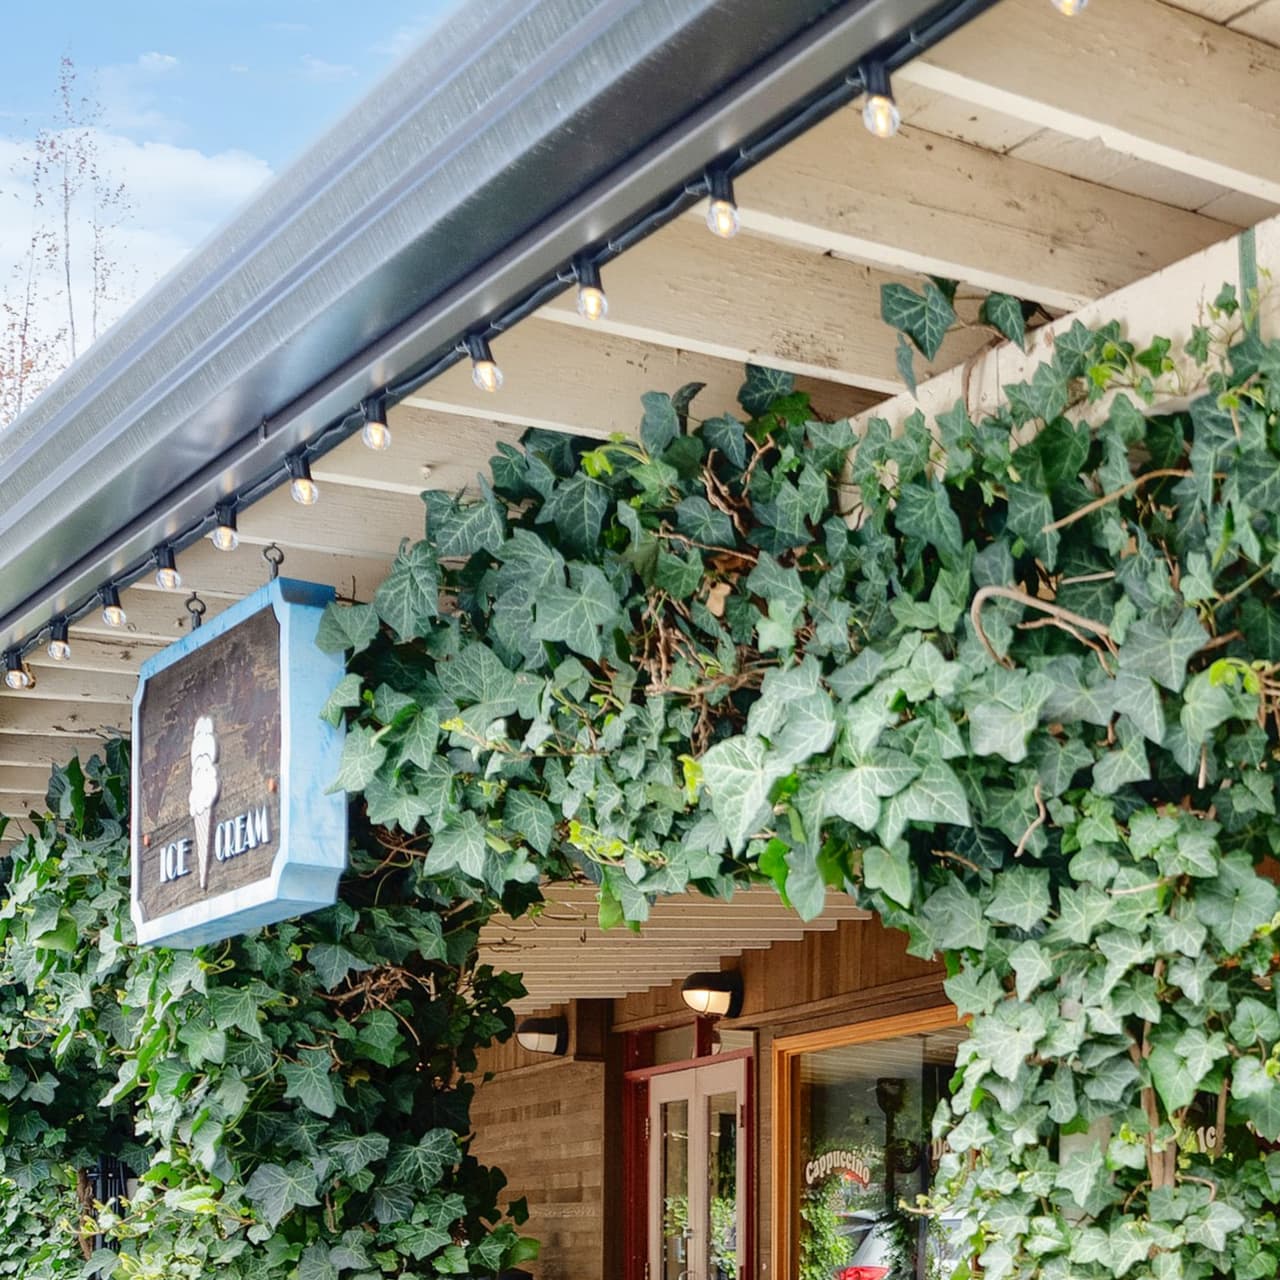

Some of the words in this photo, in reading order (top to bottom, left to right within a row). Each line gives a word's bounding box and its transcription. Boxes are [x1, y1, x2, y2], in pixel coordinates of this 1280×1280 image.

[160, 837, 189, 883] ICE
[214, 804, 270, 863] CREAM
[805, 1150, 870, 1185] Cappuccino
